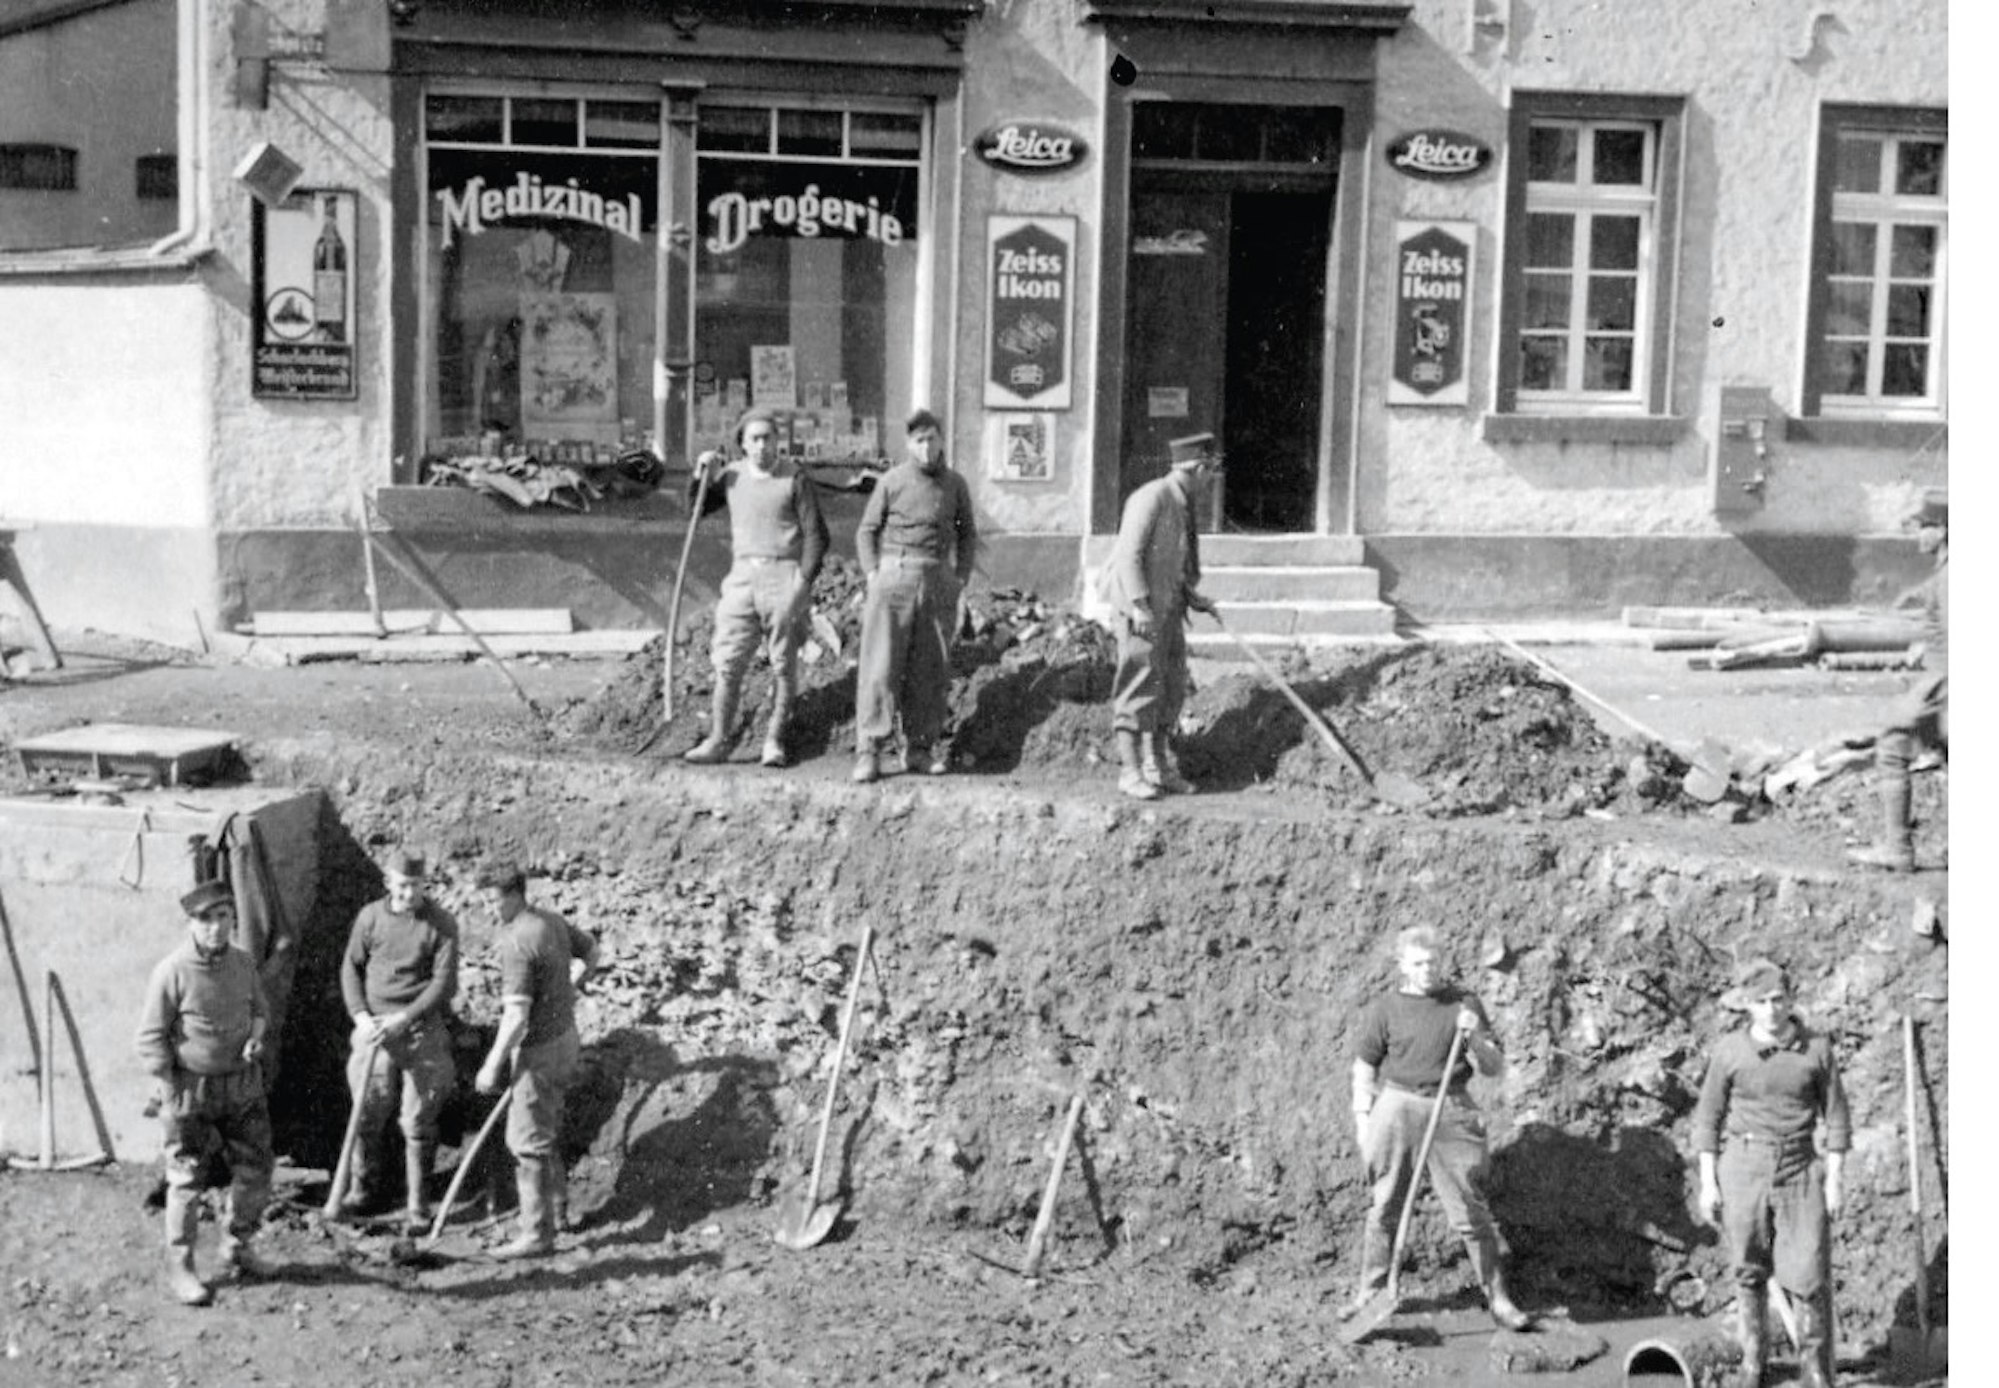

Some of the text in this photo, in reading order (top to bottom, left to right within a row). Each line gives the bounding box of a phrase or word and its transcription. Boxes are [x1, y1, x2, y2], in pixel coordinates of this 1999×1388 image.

[984, 126, 1073, 167] Leica
[1395, 133, 1480, 173] Leica
[436, 171, 902, 254] Medizinal Drogerie
[998, 246, 1062, 274] Zeiss
[1403, 248, 1464, 276] Zeiss
[998, 274, 1061, 299] Ikon
[1402, 275, 1463, 300] Ikon
